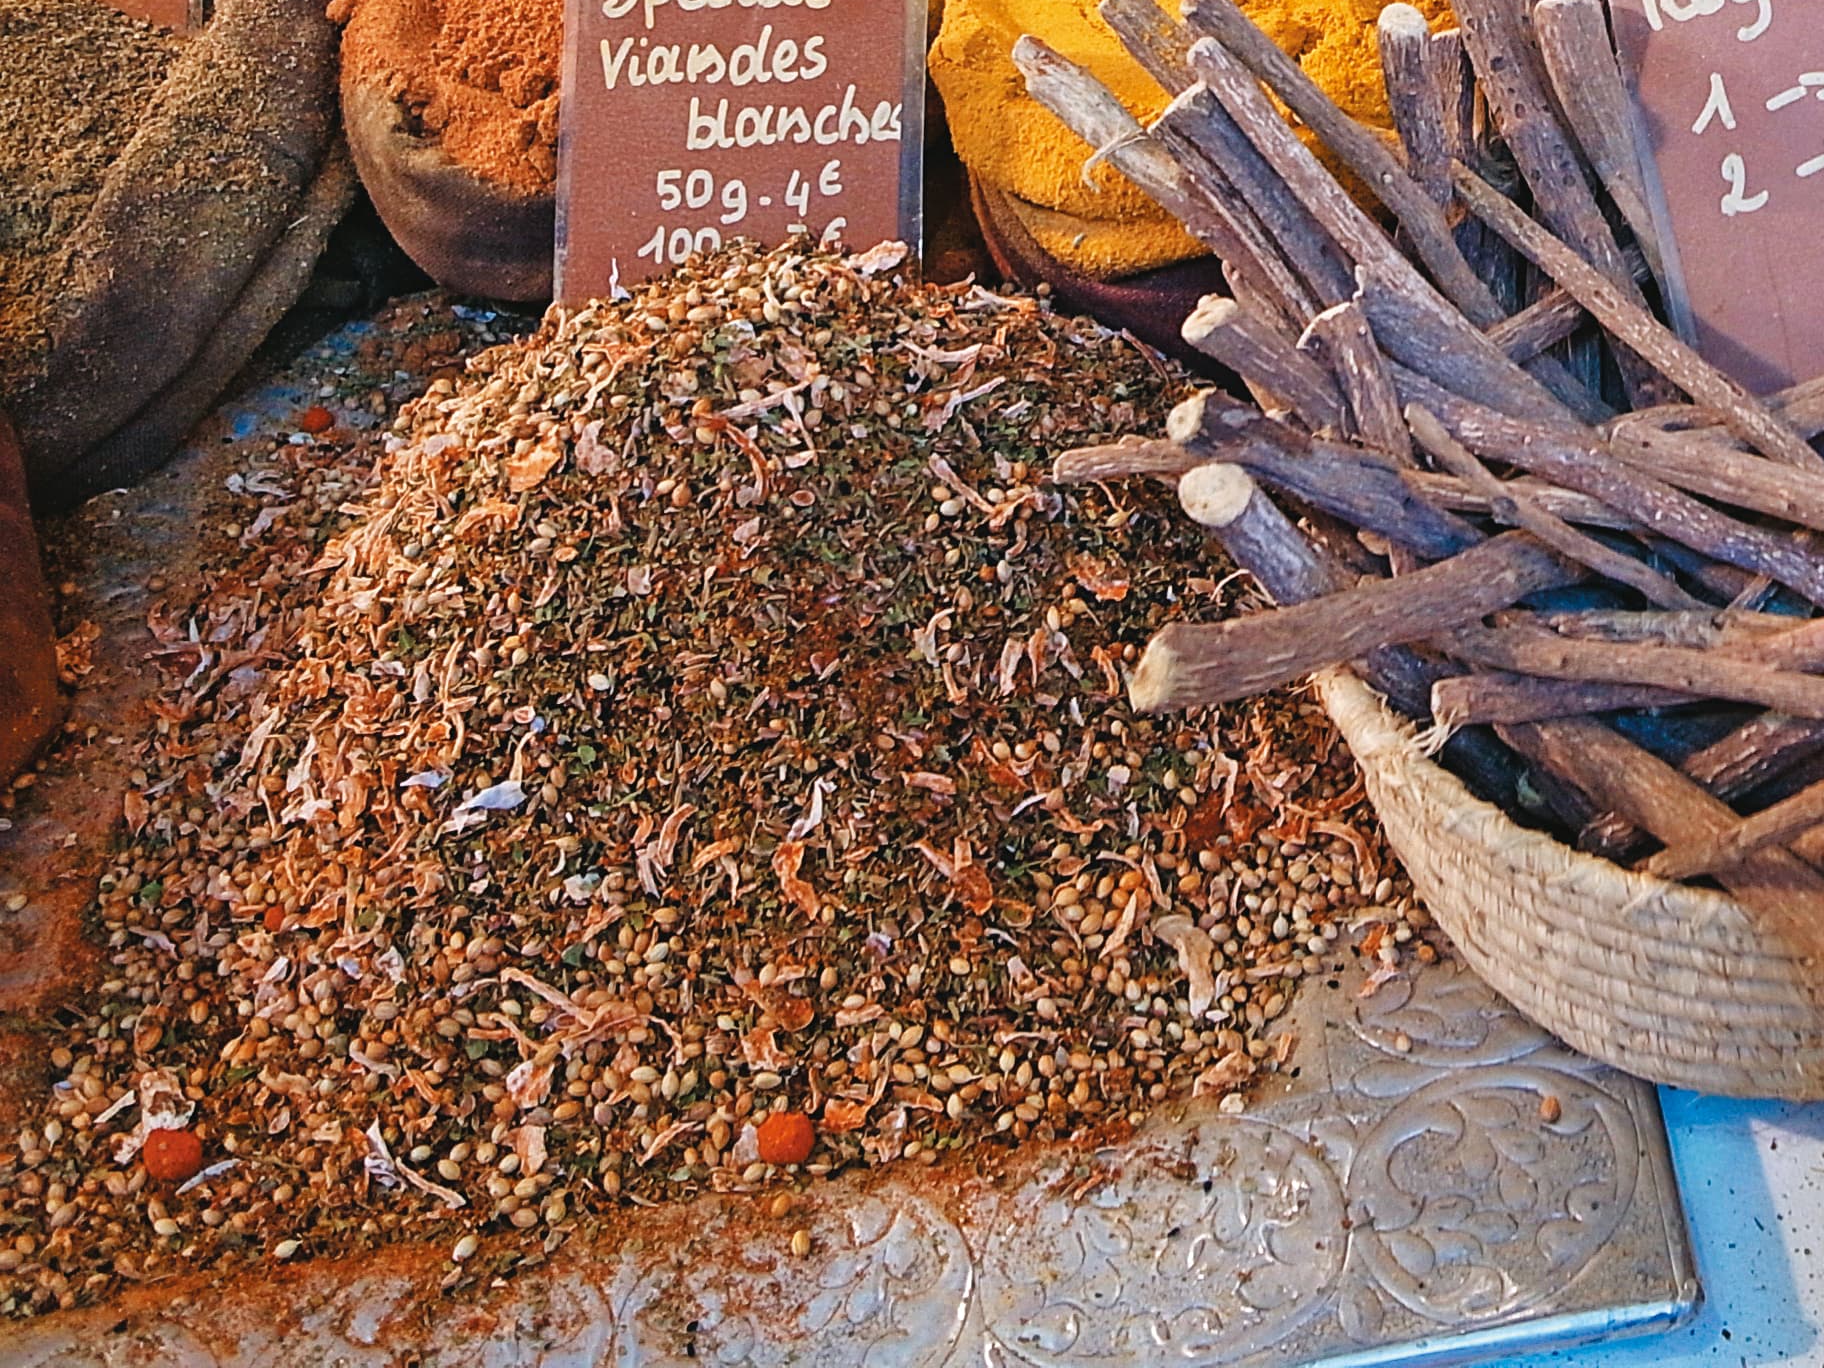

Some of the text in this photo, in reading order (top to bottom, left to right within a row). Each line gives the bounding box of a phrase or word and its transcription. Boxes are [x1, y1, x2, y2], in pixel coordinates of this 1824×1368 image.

[599, 23, 829, 90] Viandes
[1691, 72, 1737, 135] 1
[1720, 151, 1770, 216] 2
